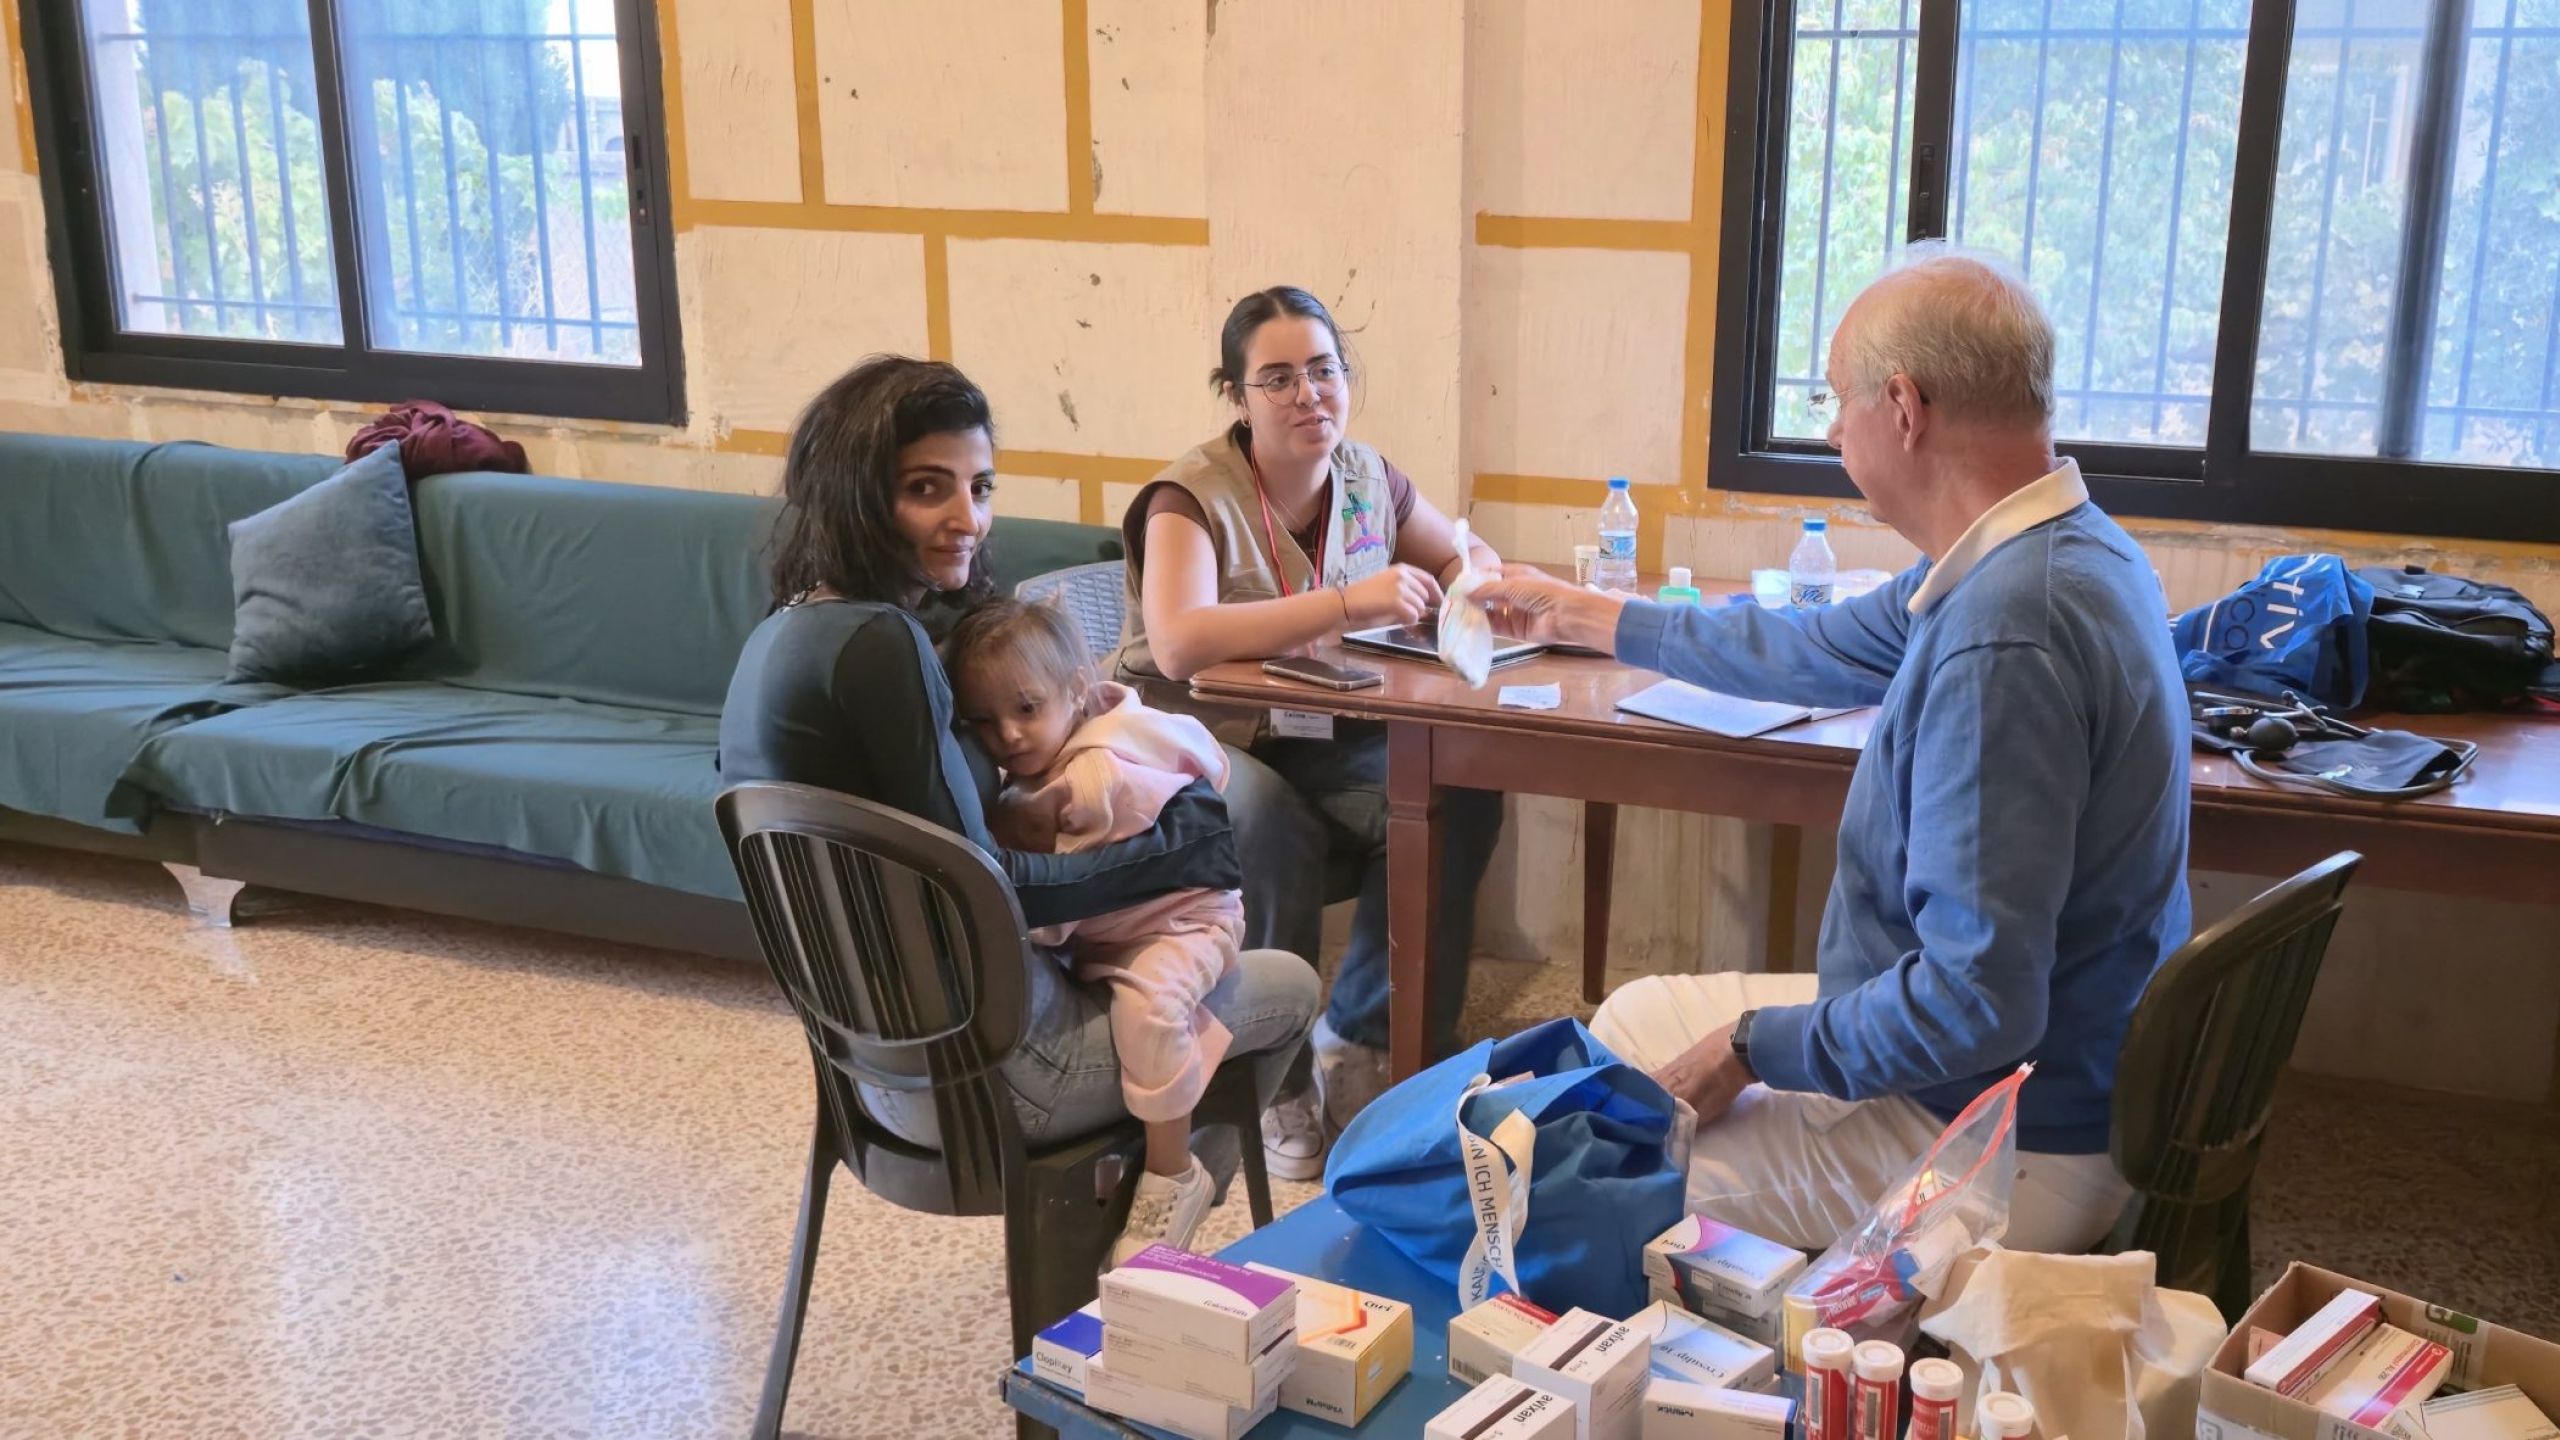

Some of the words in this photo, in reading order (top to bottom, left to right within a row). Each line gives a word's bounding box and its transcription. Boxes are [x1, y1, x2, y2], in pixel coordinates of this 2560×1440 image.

[1474, 1164, 1492, 1192] ICH
[1479, 1199, 1504, 1268] MENSCH
[1595, 1326, 1630, 1352] avixan
[1512, 1394, 1553, 1423] avixan
